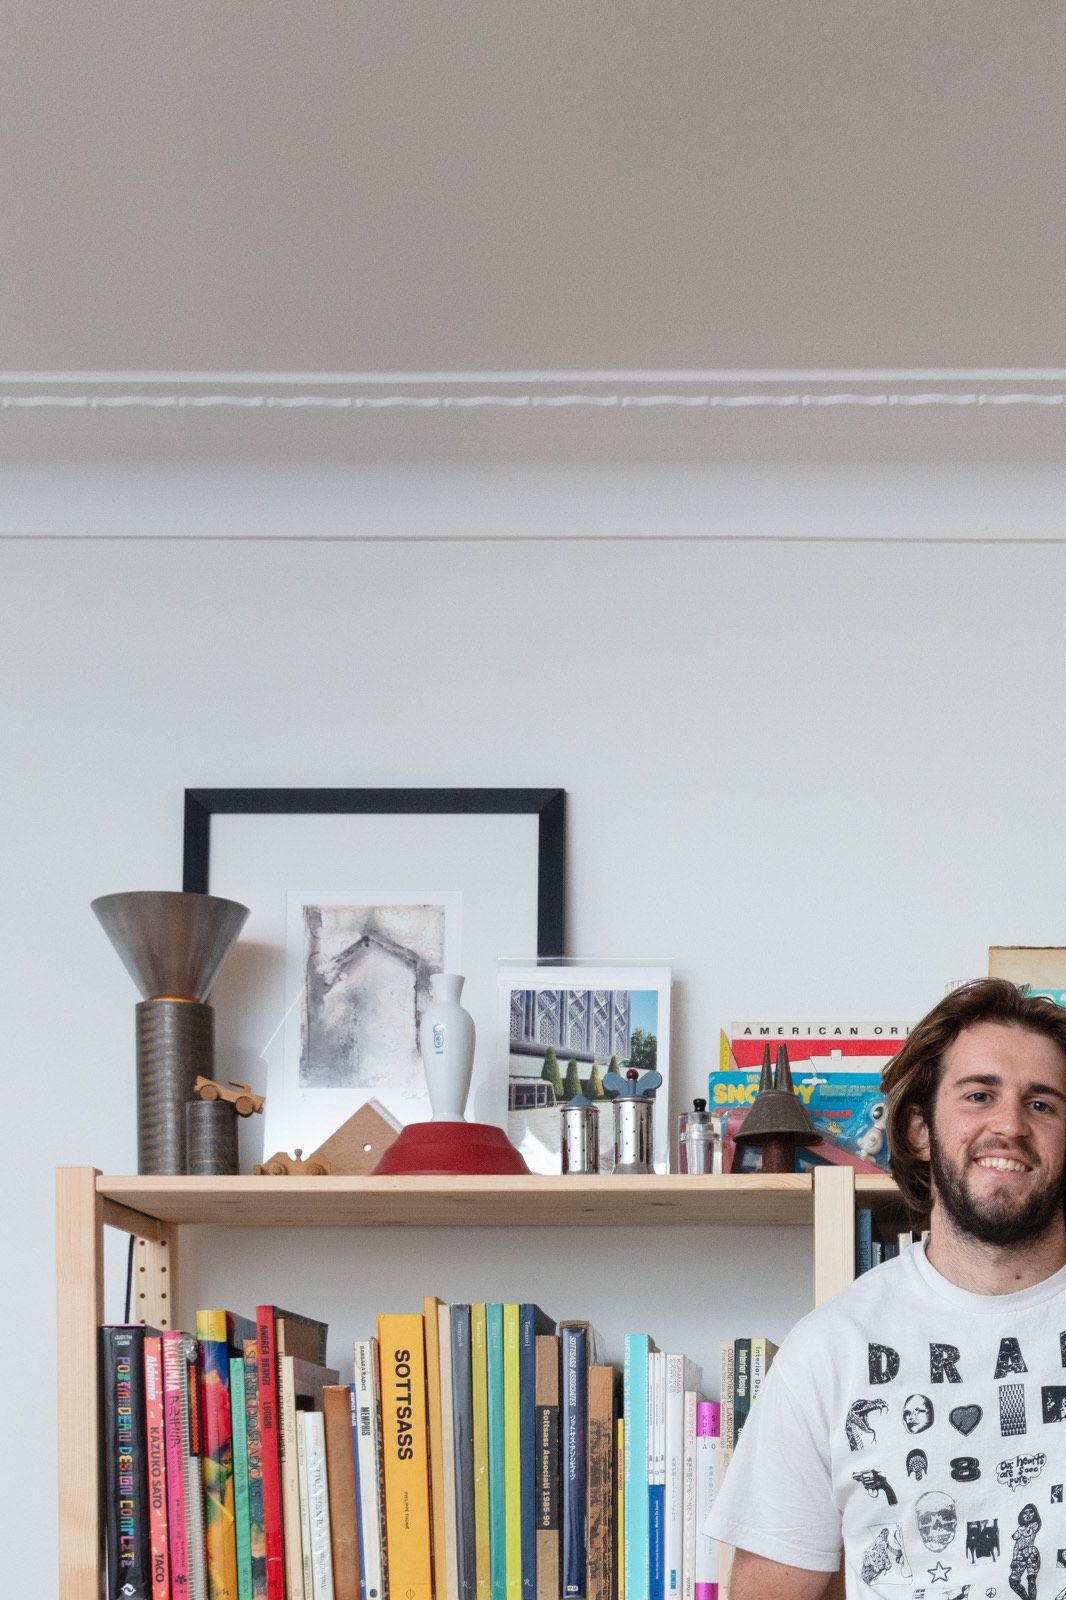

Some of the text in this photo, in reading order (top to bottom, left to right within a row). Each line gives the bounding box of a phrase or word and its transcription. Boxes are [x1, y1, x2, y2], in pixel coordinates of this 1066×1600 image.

[744, 1027, 858, 1035] AMERICAN
[713, 1083, 814, 1104] SNOY
[569, 1369, 577, 1406] ASSOCIATES
[738, 1349, 748, 1396] Interior Design
[360, 1407, 371, 1436] MEMPHIS
[394, 1349, 413, 1461] SOTTSASS
[726, 1407, 734, 1449] LANDSCAPE
[146, 1355, 165, 1582] Alchimia KAZUKO SATO TACO
[542, 1409, 551, 1526] Sottsass Associati 1985-90
